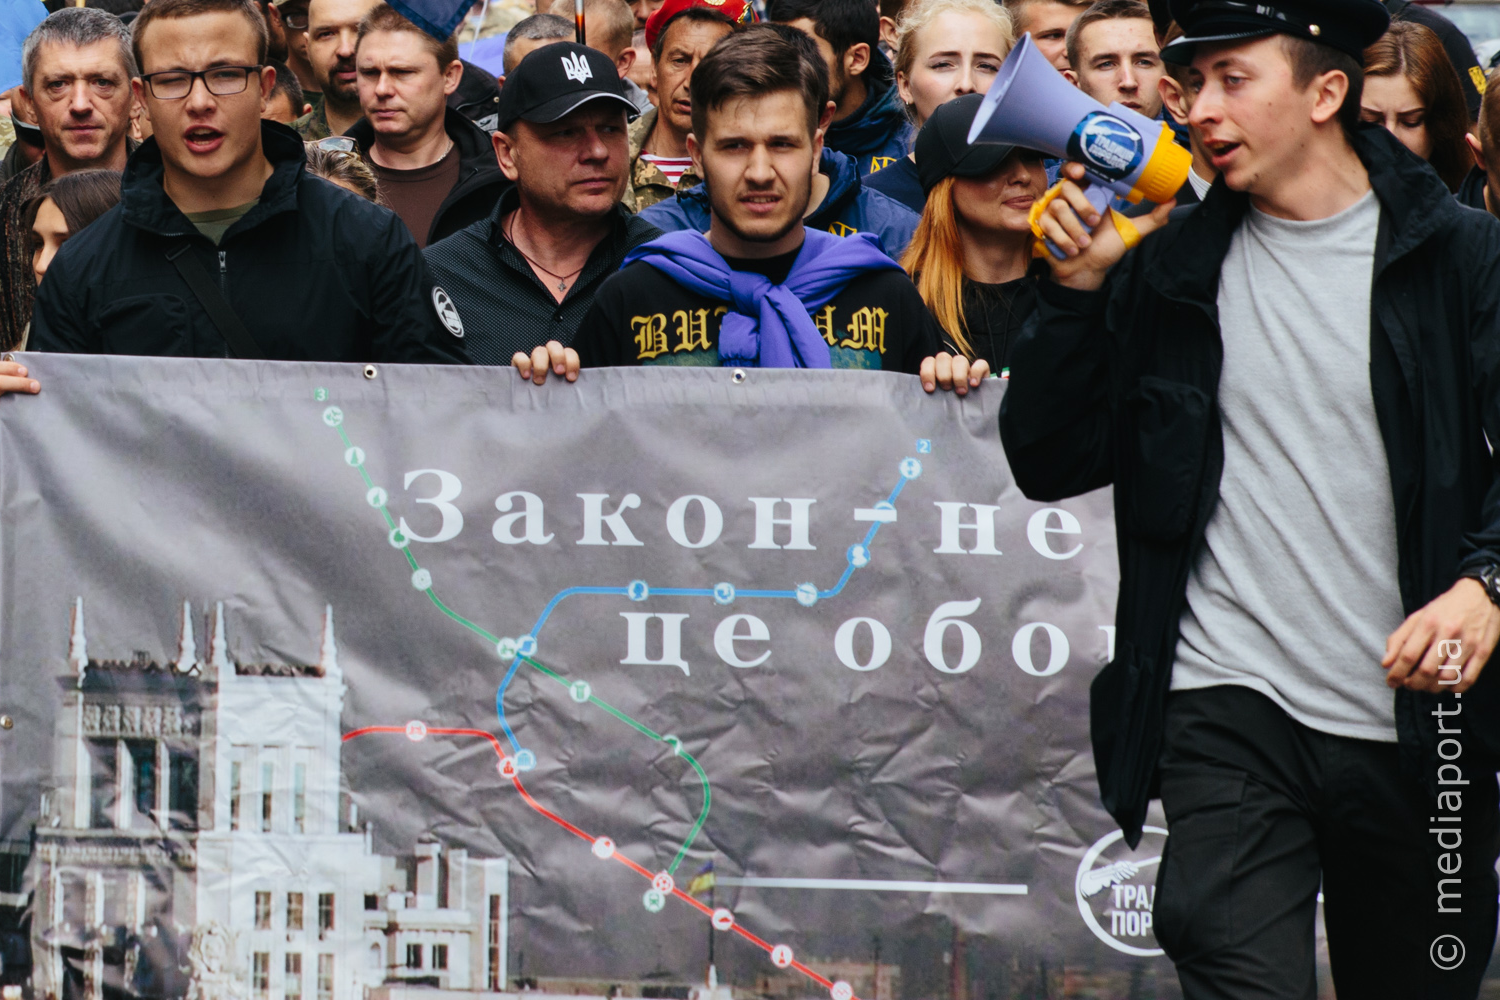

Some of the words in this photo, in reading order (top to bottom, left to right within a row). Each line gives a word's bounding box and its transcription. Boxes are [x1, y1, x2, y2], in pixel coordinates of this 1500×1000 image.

[399, 469, 817, 549] Закон
[933, 501, 1084, 560] не
[619, 611, 773, 676] це
